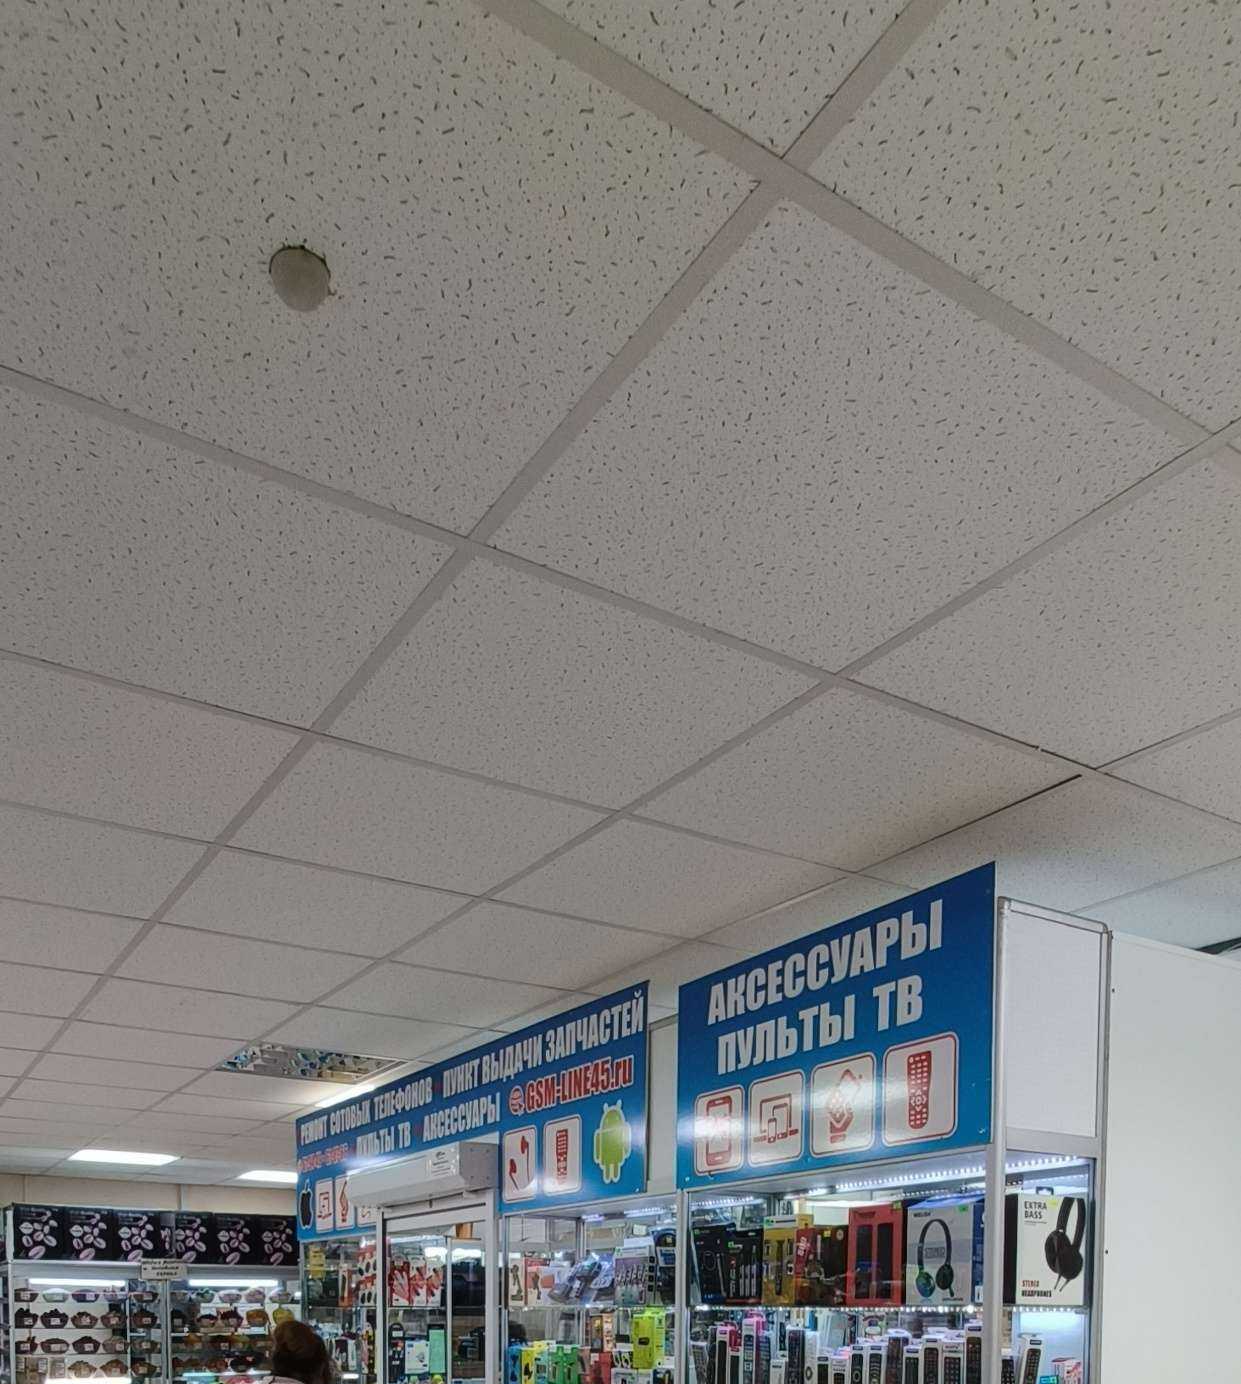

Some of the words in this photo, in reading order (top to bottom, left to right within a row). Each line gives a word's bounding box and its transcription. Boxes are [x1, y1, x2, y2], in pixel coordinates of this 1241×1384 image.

[707, 899, 943, 1025] АКСЕССУАРЫ
[717, 994, 855, 1075] ПУЛЬТЫ
[872, 974, 924, 1032] ТВ
[330, 1099, 370, 1135] СОТОВЫХ
[374, 1076, 433, 1120] ТЕЛЕФОНОВ
[443, 1058, 480, 1098] ПУНКТ
[482, 1034, 542, 1084] ВЫДАЧИ
[545, 989, 644, 1062] ЗАПЧАСТЕЙ
[525, 1055, 634, 1112] GSM-LINE45.ru
[398, 1121, 411, 1149] ТВ
[423, 1092, 500, 1142] АКСЕССУАРЫ
[1024, 1200, 1047, 1210] EXTRA
[1024, 1210, 1043, 1219] BASS
